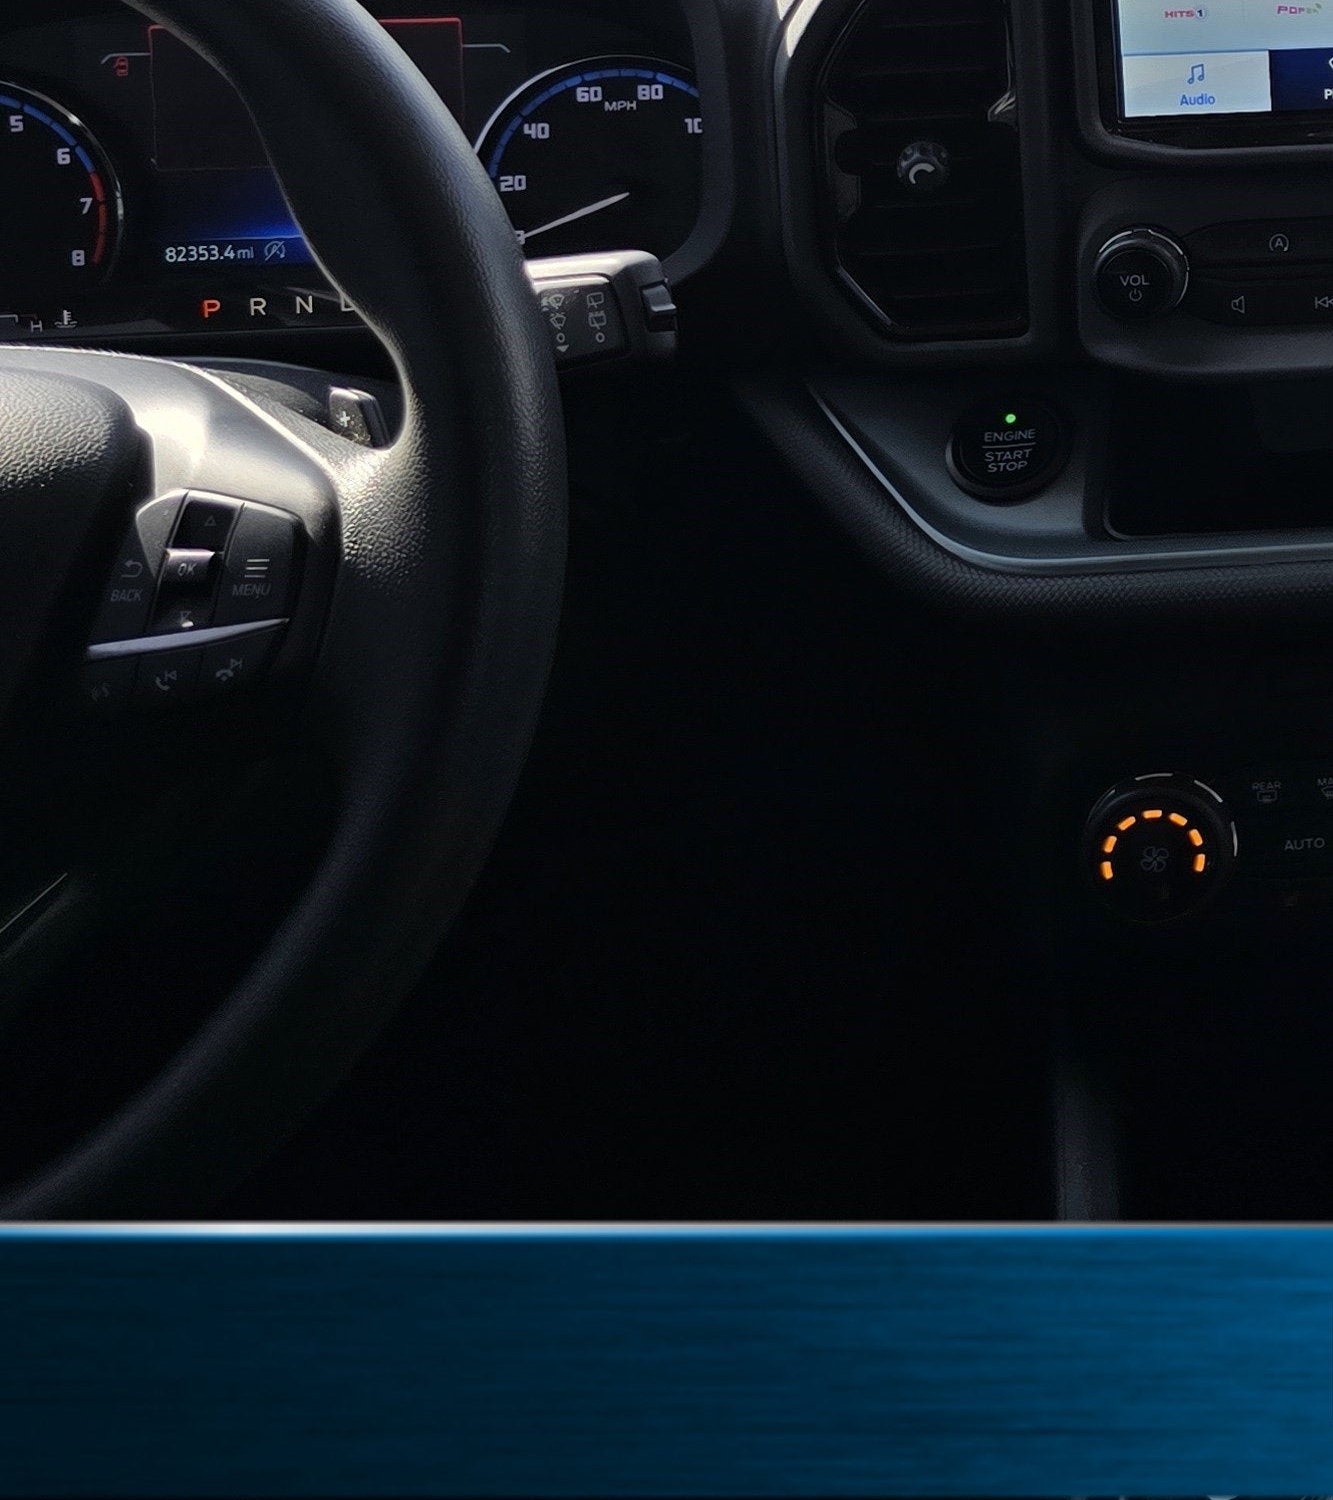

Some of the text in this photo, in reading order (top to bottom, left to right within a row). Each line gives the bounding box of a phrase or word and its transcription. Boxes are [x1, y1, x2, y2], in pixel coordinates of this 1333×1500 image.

[1164, 10, 1194, 18] HITS
[576, 86, 603, 102] 60
[637, 84, 664, 100] 80
[604, 100, 637, 112] MPH
[1180, 93, 1216, 106] Audio
[9, 115, 24, 133] 5
[523, 122, 550, 139] 40
[56, 148, 71, 165] 6
[500, 174, 527, 192] 20
[79, 197, 93, 215] 7
[71, 249, 86, 267] 8
[1119, 274, 1150, 287] VOL
[203, 295, 313, 318] P R N
[30, 320, 43, 333] H
[983, 428, 1037, 443] ENGINE
[984, 449, 1033, 462] START
[987, 461, 1028, 473] STOP
[177, 563, 198, 576] OK
[110, 588, 144, 602] BACK
[232, 584, 272, 598] MENU
[1252, 781, 1281, 791] REAR
[1284, 837, 1326, 851] AUTO
